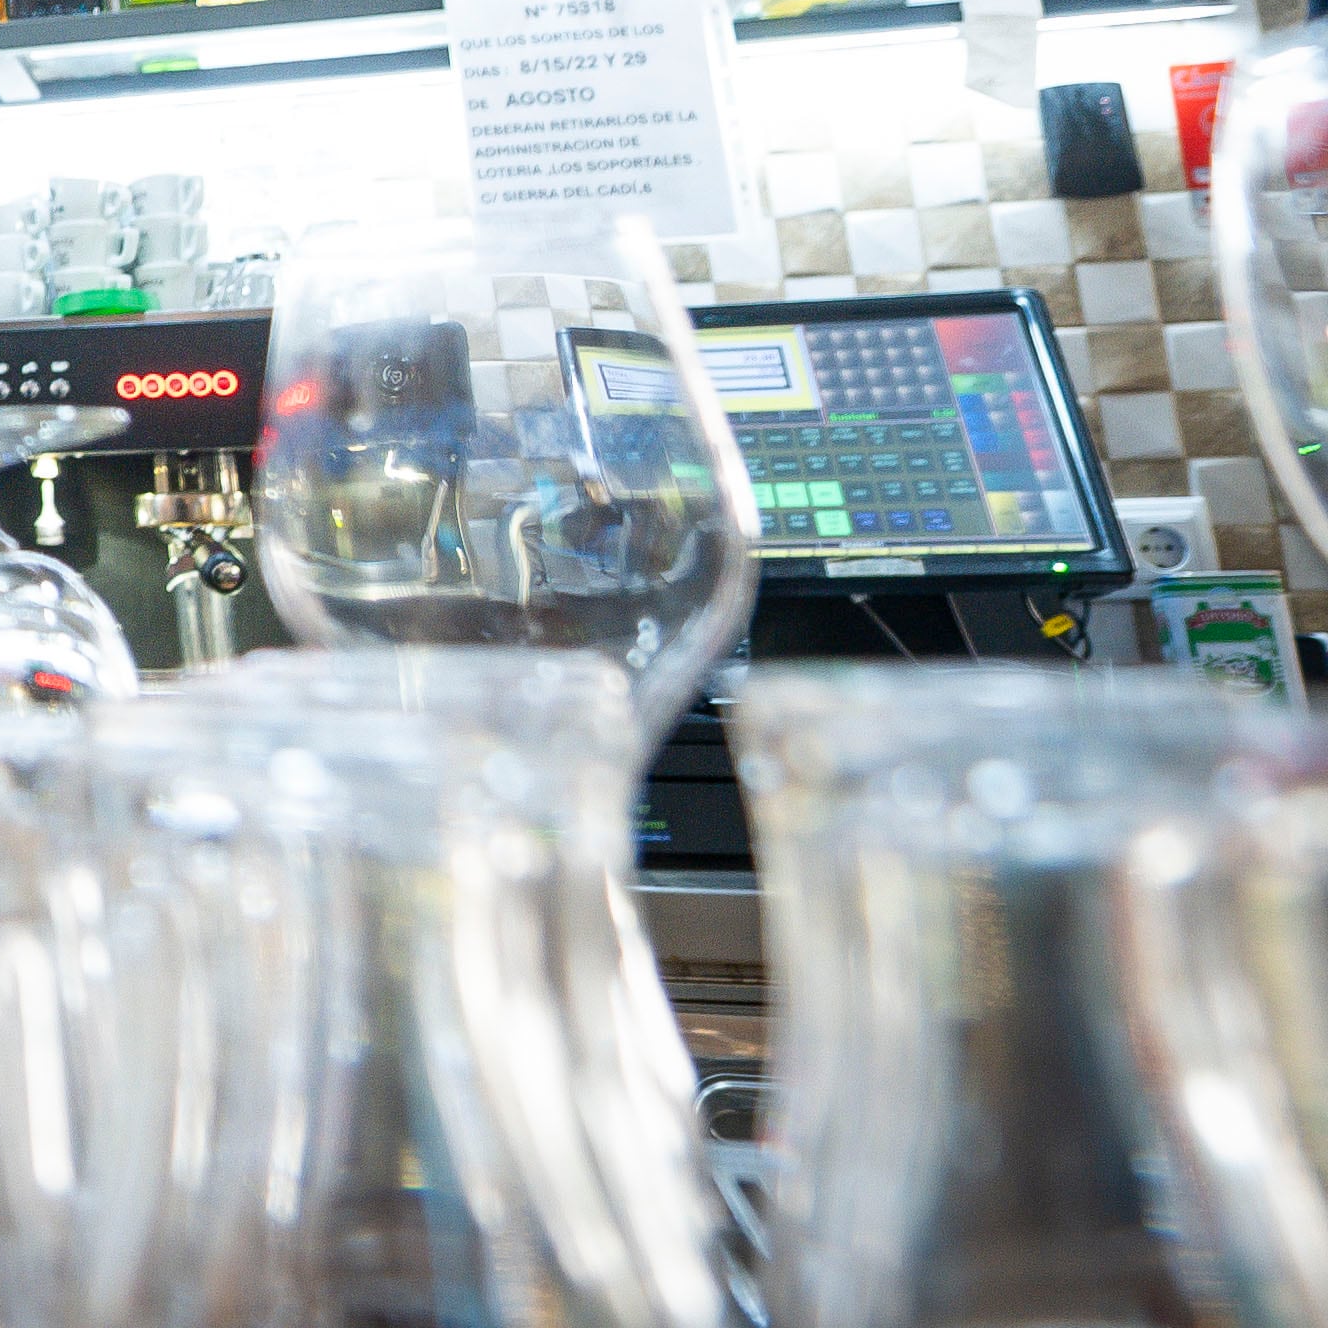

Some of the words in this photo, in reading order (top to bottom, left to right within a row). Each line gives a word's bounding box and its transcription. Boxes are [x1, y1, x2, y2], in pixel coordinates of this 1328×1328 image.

[459, 35, 495, 51] QUE
[497, 33, 528, 48] LOS
[530, 29, 605, 46] SORTEOS
[608, 26, 630, 39] DE
[633, 23, 666, 37] LOS
[518, 54, 598, 74] 8/15/22
[603, 52, 616, 67] Y
[467, 98, 490, 112] DE
[505, 86, 596, 108] AGOSTO
[471, 122, 546, 139] DEBERAN
[550, 112, 650, 132] RETIRARLOS
[652, 110, 674, 123] DE
[677, 109, 699, 122] LA
[474, 136, 615, 160] ADMINISTRACION
[618, 134, 640, 148] DE
[477, 163, 542, 181] LOTERIA
[586, 152, 694, 172] SOPORTALES
[502, 184, 560, 204] SIERRA
[562, 184, 591, 200] DEL
